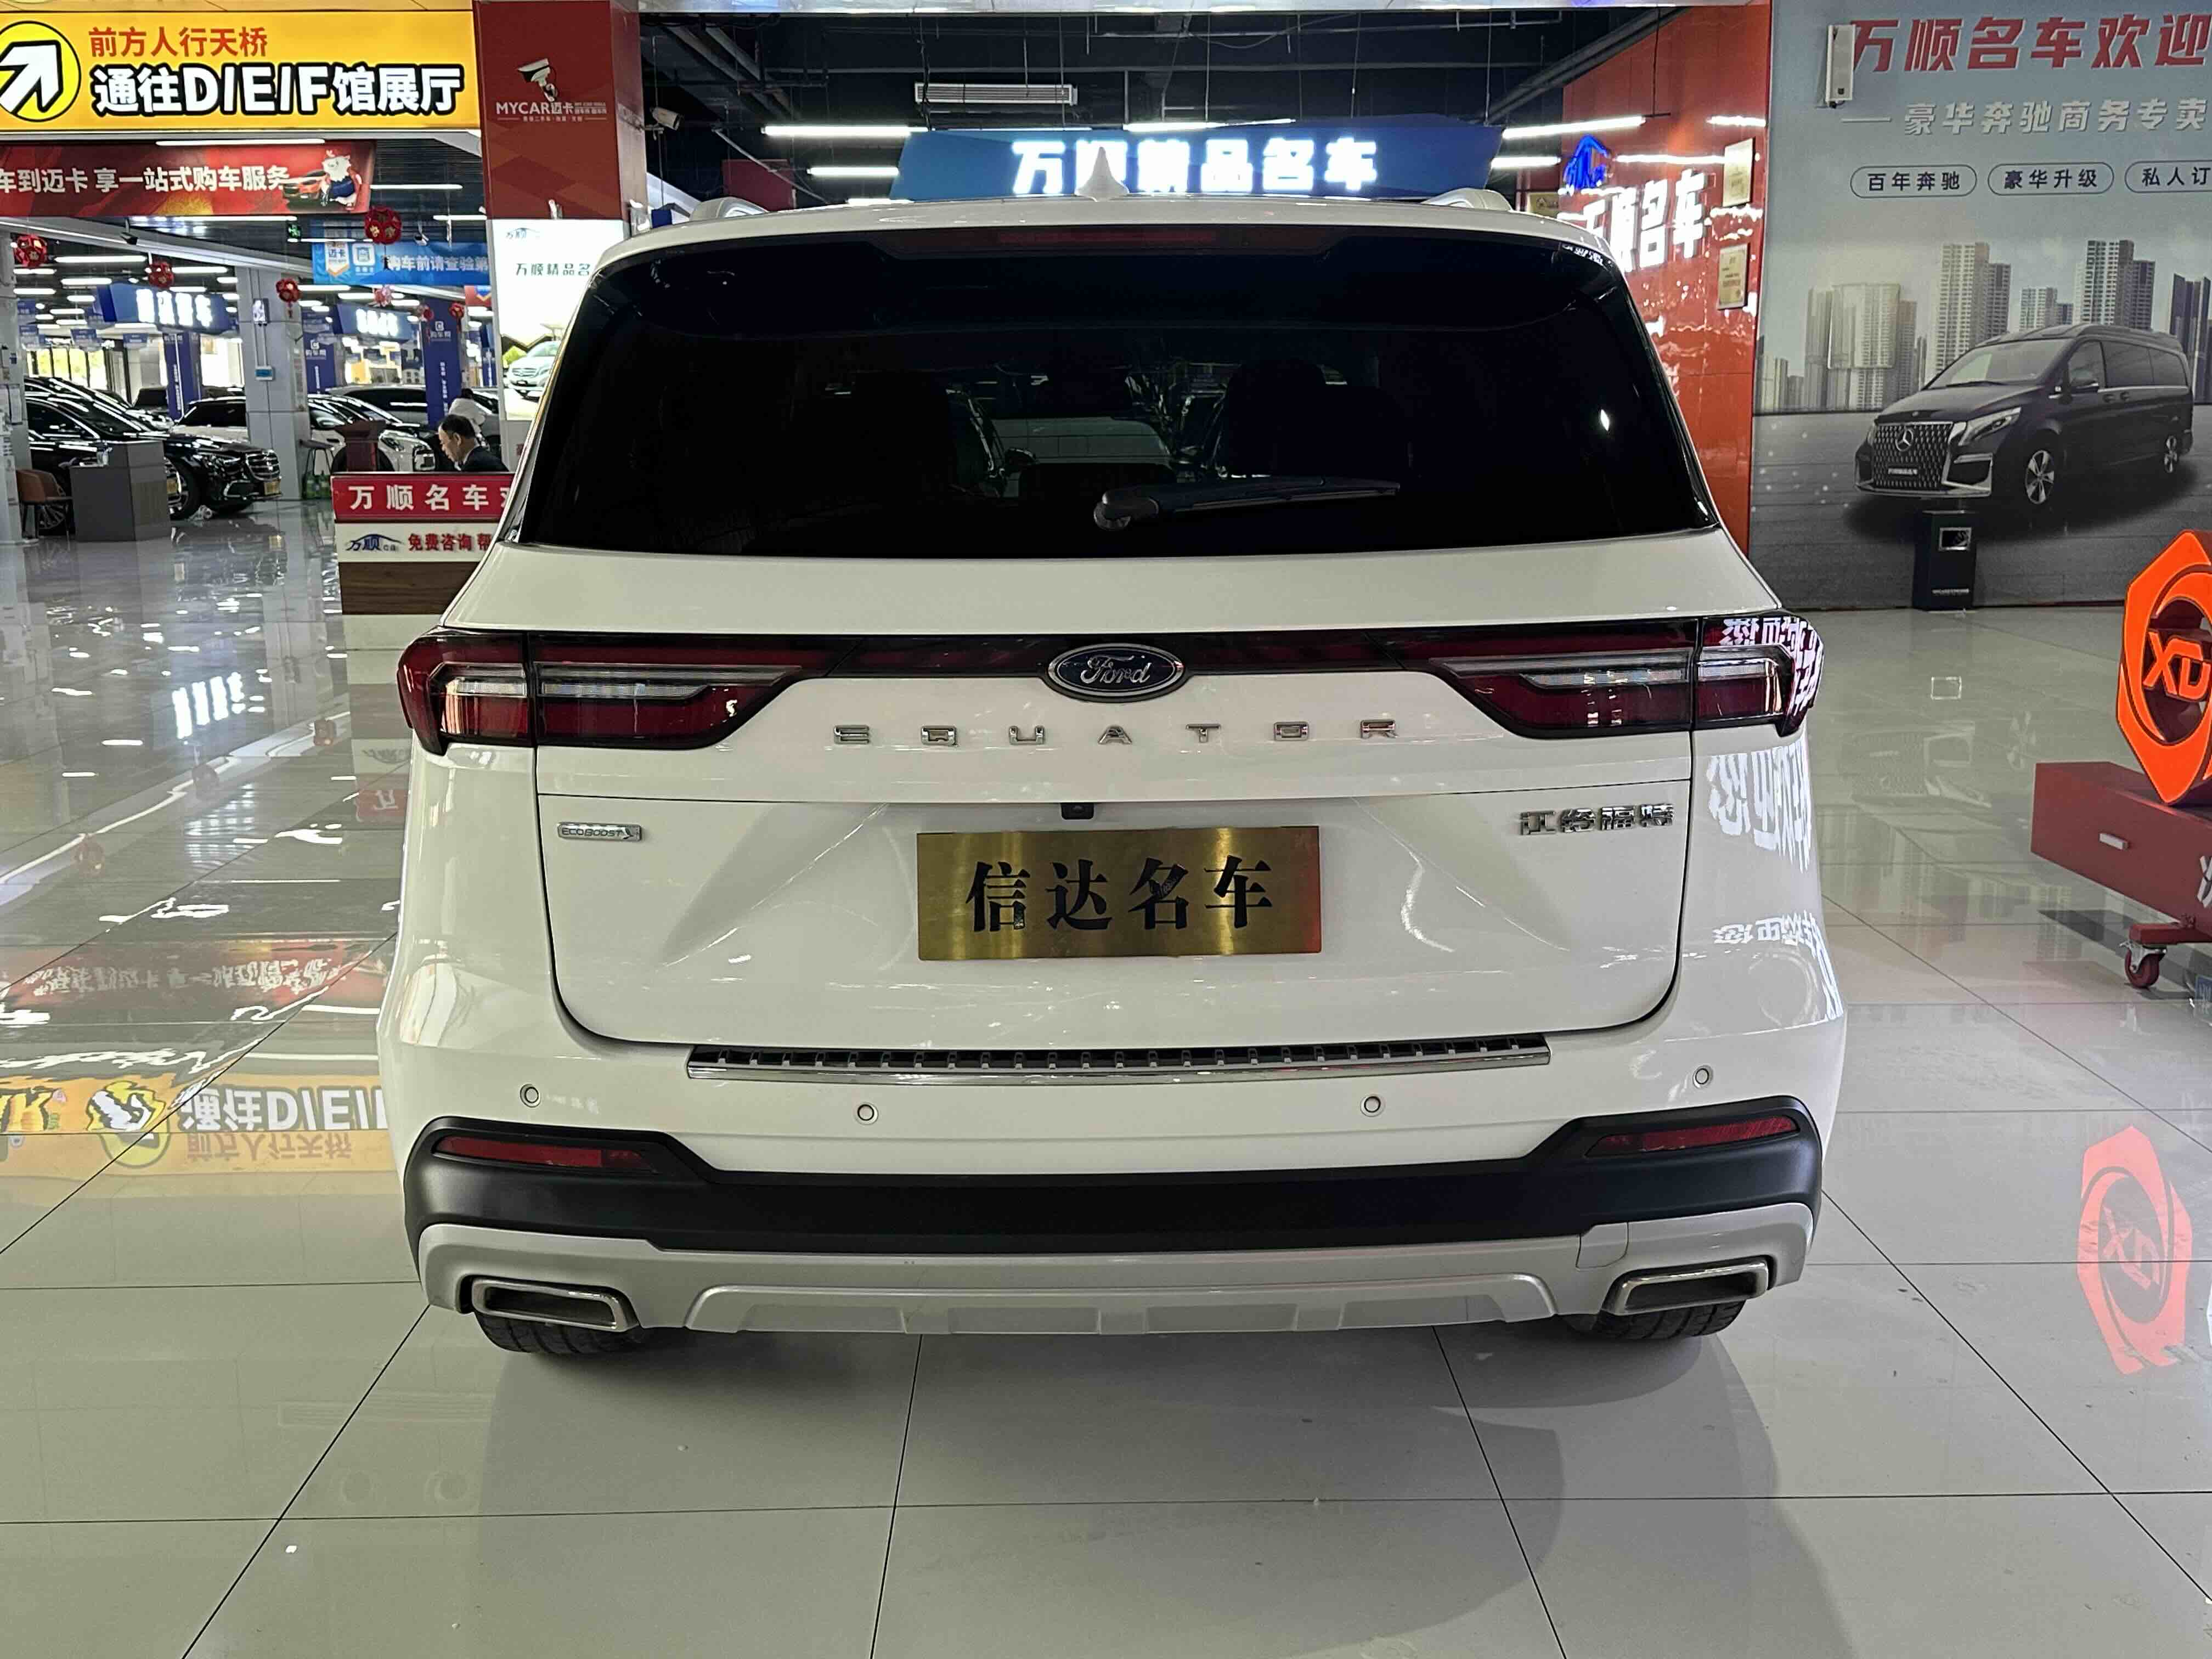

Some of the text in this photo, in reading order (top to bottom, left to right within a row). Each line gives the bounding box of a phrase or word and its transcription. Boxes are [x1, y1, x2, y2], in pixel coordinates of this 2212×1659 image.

[89, 27, 268, 57] 前方人行天桥
[1853, 13, 2212, 72] 万顺名车欢迎
[1904, 98, 2207, 136] 豪华奔驰商务专卖
[0, 166, 290, 193] 车到迈卡 享一站式购车服务
[1867, 171, 1960, 192] 百年奔驰
[2004, 168, 2098, 190] 豪华升级
[2141, 166, 2211, 188] 私人订
[516, 263, 590, 276] 万顺精品名
[1078, 653, 1153, 687] Ford
[833, 718, 1400, 747] EQUATOR
[966, 854, 1274, 932] 信达名车
